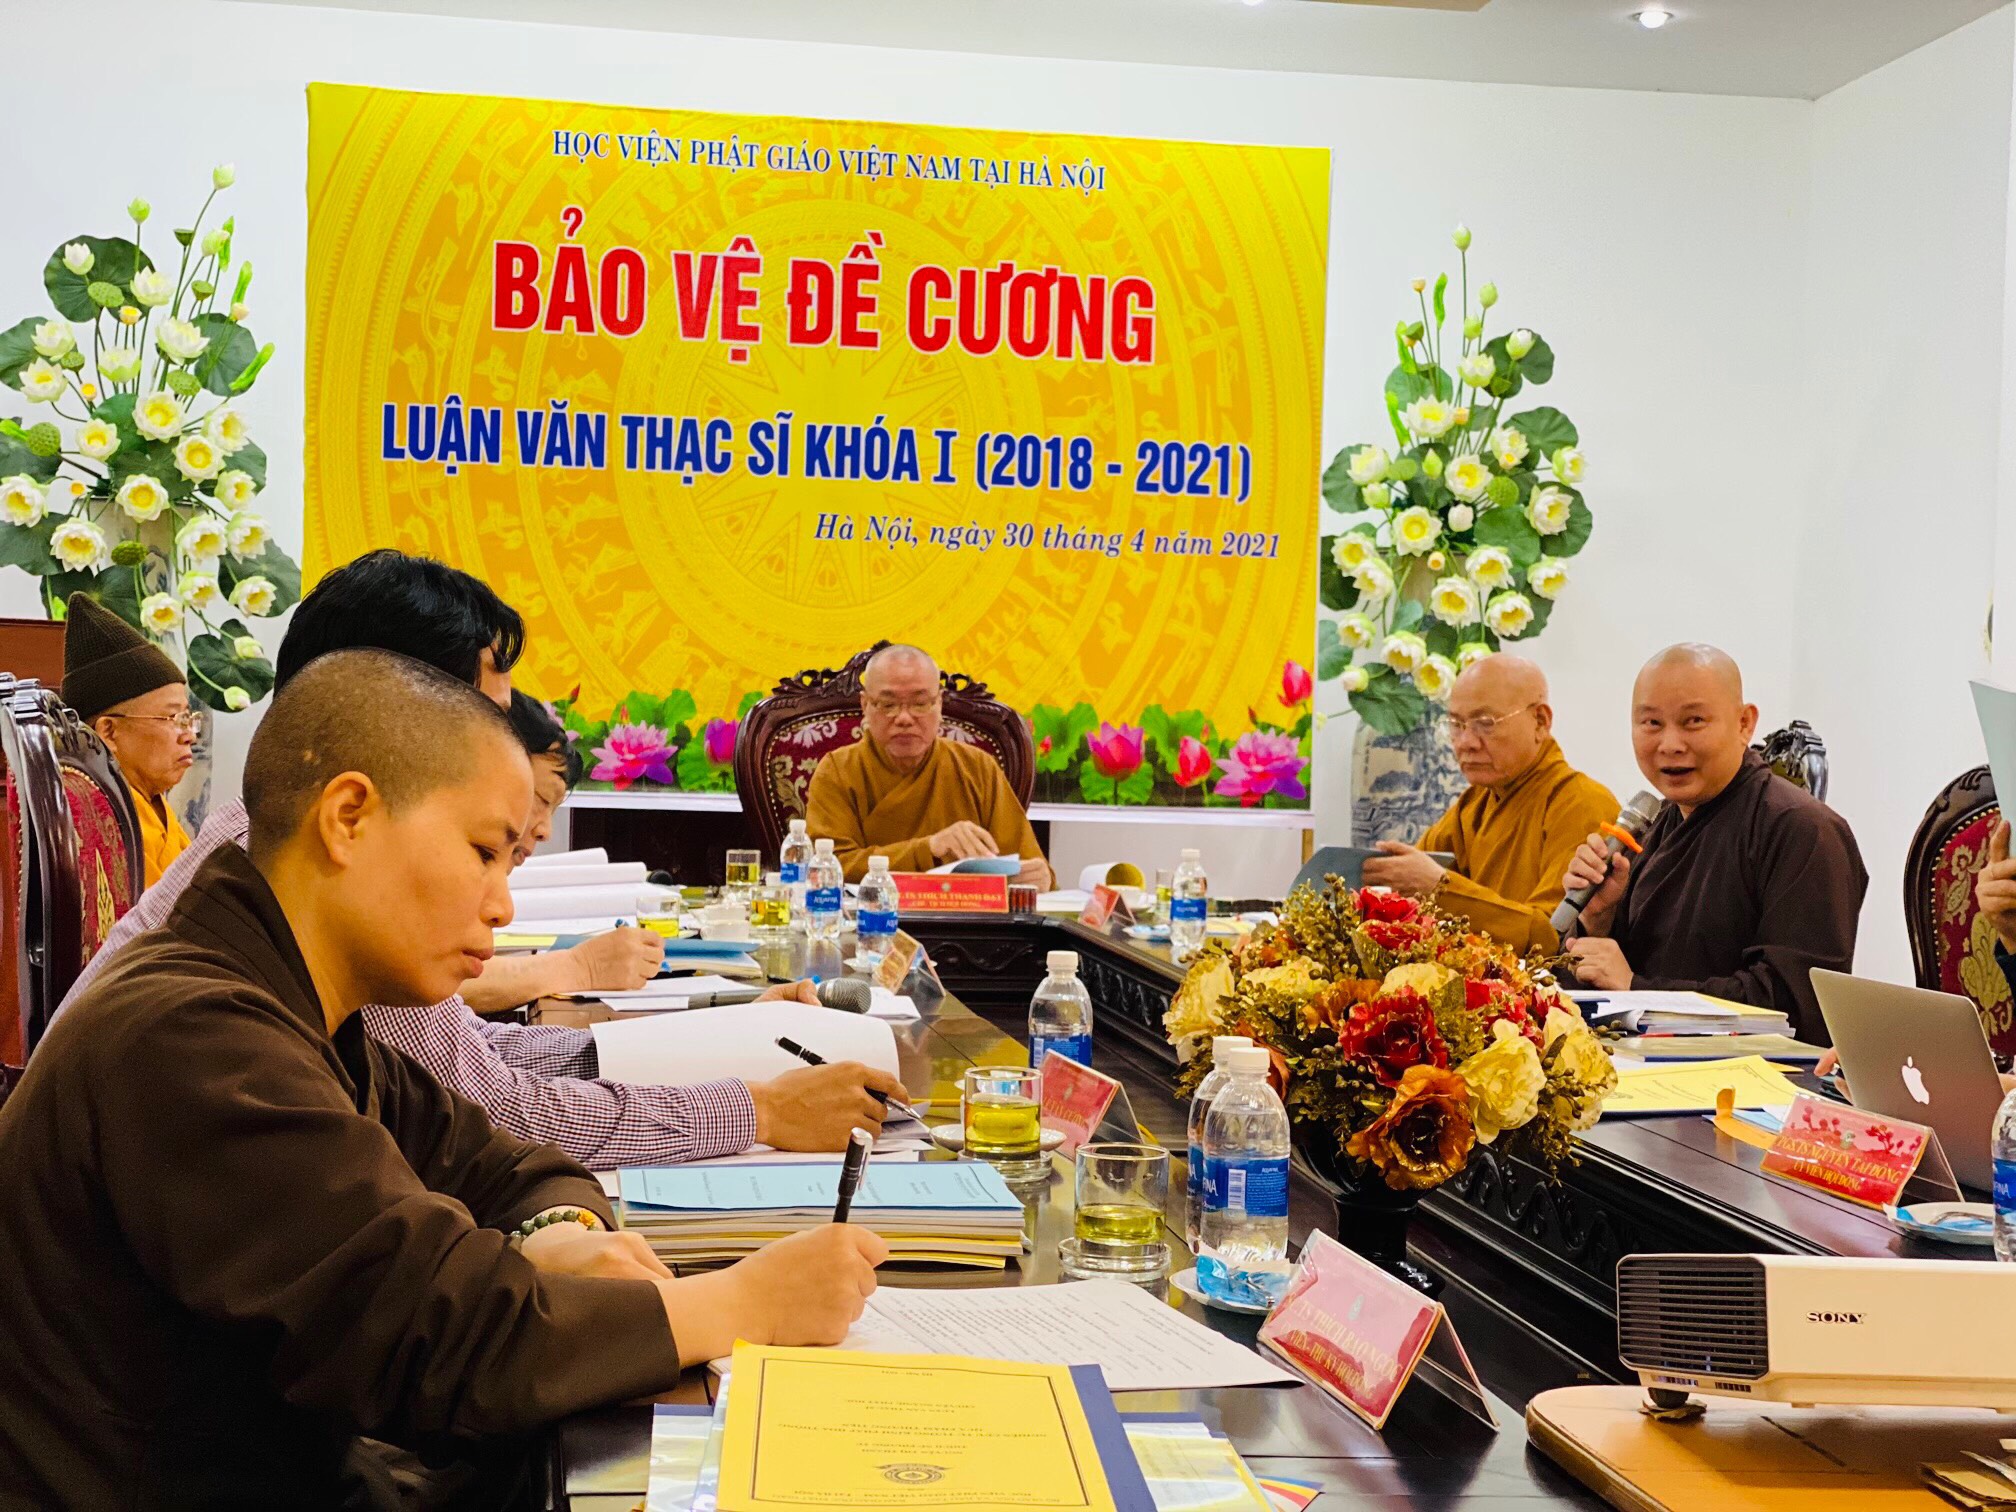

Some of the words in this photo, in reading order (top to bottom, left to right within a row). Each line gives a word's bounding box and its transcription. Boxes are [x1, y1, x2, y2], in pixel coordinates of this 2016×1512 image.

[554, 130, 610, 164] HỌC
[617, 129, 681, 169] VIỆN
[691, 136, 760, 173] PHẬT
[767, 140, 832, 172] GIÁO
[839, 145, 898, 182] VIỆT
[906, 155, 961, 181] NAM
[970, 158, 1011, 189] TẠI
[1019, 157, 1054, 188] HÀ
[1062, 159, 1105, 196] NỘI
[494, 206, 647, 337] BẢO
[673, 237, 762, 362] VỆ
[786, 231, 883, 349] ĐỀ
[908, 261, 1154, 364] CƯƠNG
[382, 394, 501, 475] LUẬN
[516, 399, 606, 469] VĂN
[620, 415, 733, 485] THẠC
[747, 411, 793, 476] SĨ
[804, 415, 920, 482] KHÓA
[932, 429, 958, 484] I
[976, 432, 1093, 492] (2018
[1107, 463, 1123, 475] -
[1135, 440, 1252, 504] 2021)
[815, 514, 854, 540] Hà
[866, 516, 919, 550] Nội,
[929, 521, 996, 549] ngày
[1003, 524, 1035, 547] 30
[1044, 525, 1123, 556] tháng
[1130, 529, 1146, 552] 4
[1155, 530, 1213, 555] năm
[1222, 532, 1279, 559] 2021
[1806, 1311, 1867, 1325] SONY
